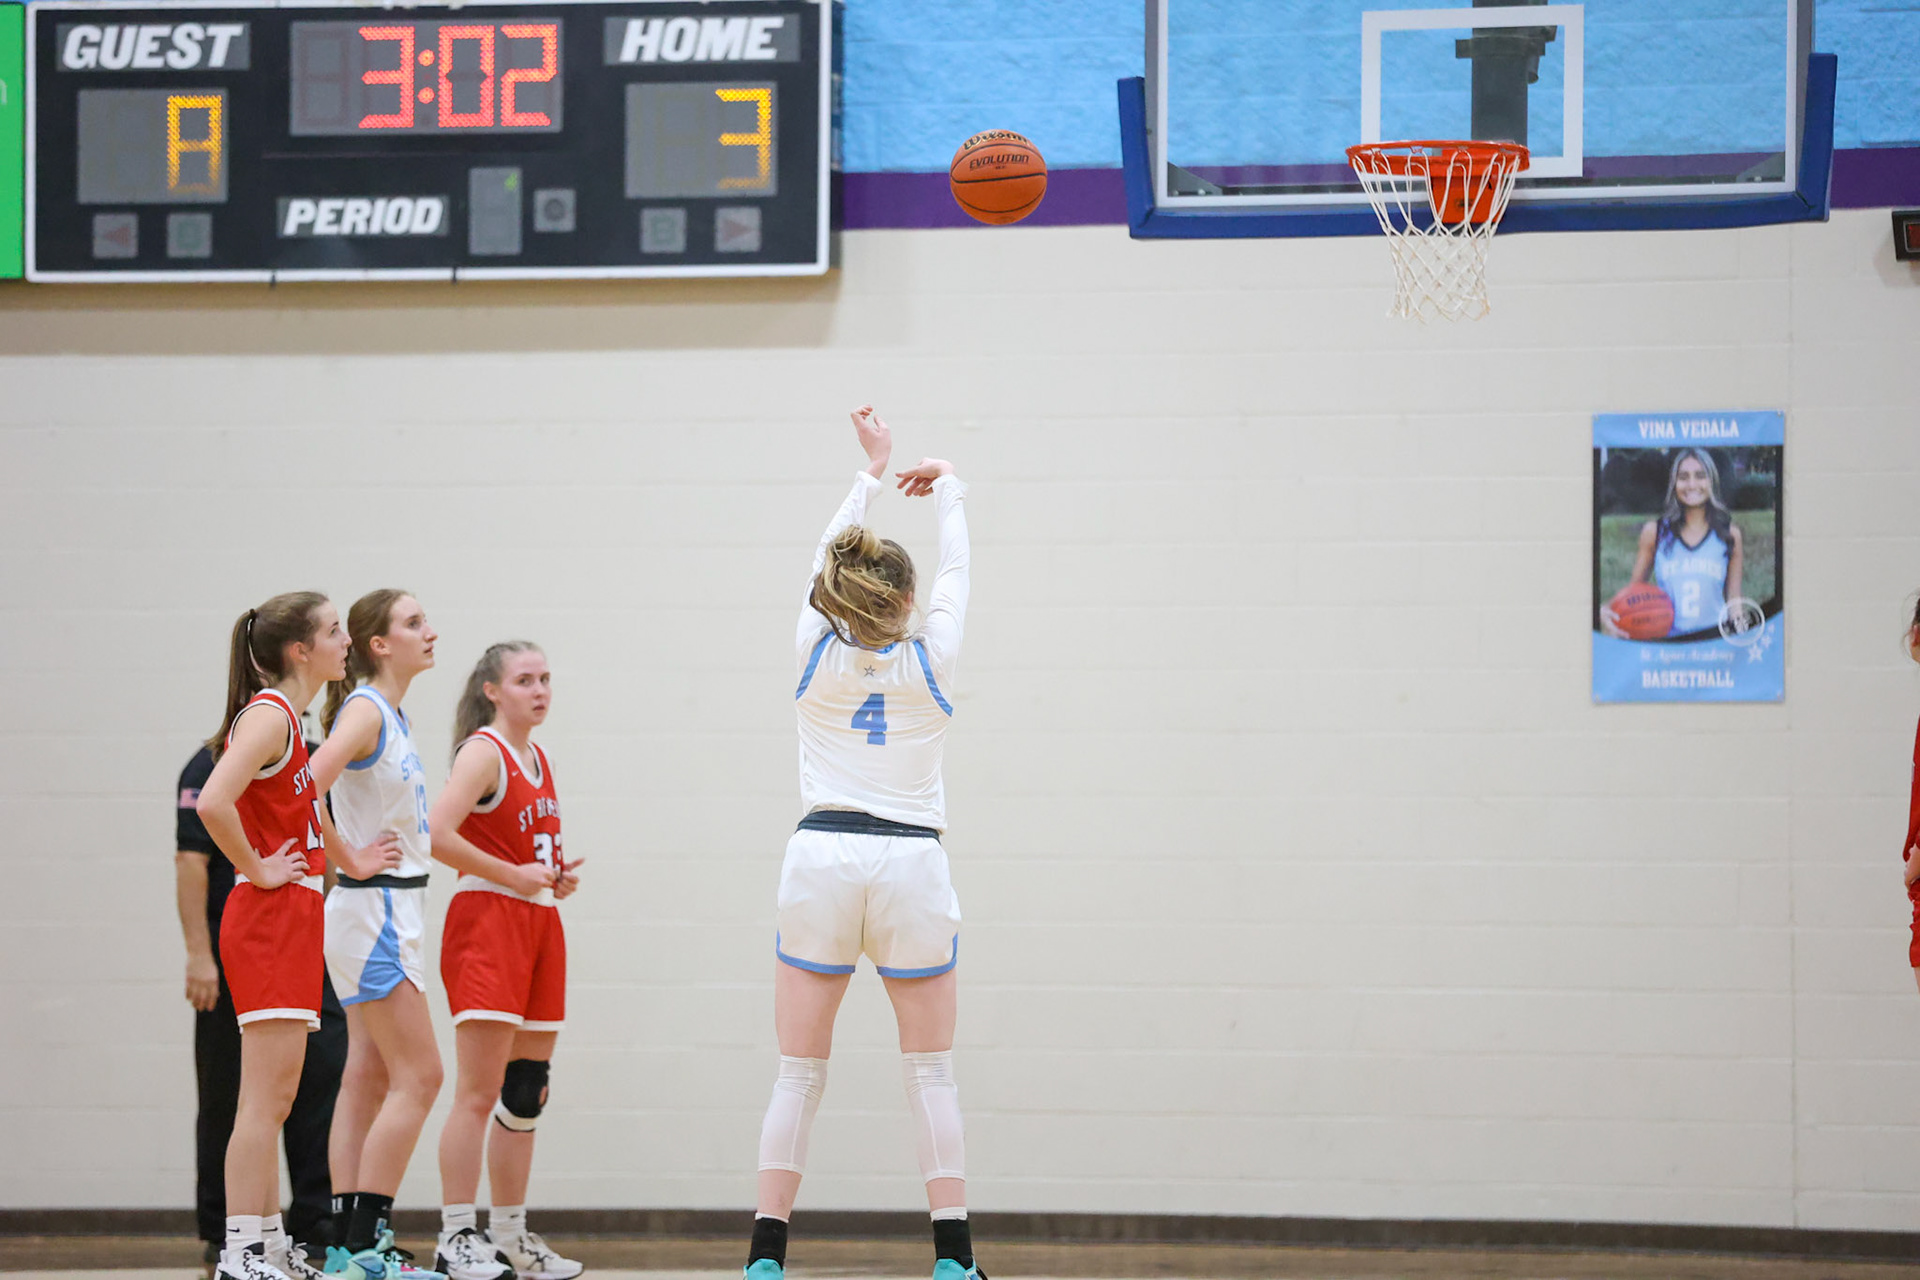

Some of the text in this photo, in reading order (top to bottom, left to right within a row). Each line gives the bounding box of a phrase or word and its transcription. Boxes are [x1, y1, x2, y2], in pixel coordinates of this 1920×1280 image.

[62, 22, 244, 70] GUEST
[619, 16, 784, 63] HOME
[358, 24, 558, 129] 3:02
[715, 88, 772, 190] 3
[969, 153, 1029, 170] EVOLUTION
[283, 197, 444, 236] PERIOD
[1638, 418, 1740, 439] VINA VEDALA
[1681, 580, 1700, 618] 2
[1642, 669, 1735, 689] BASKETBALL
[851, 693, 887, 745] 4
